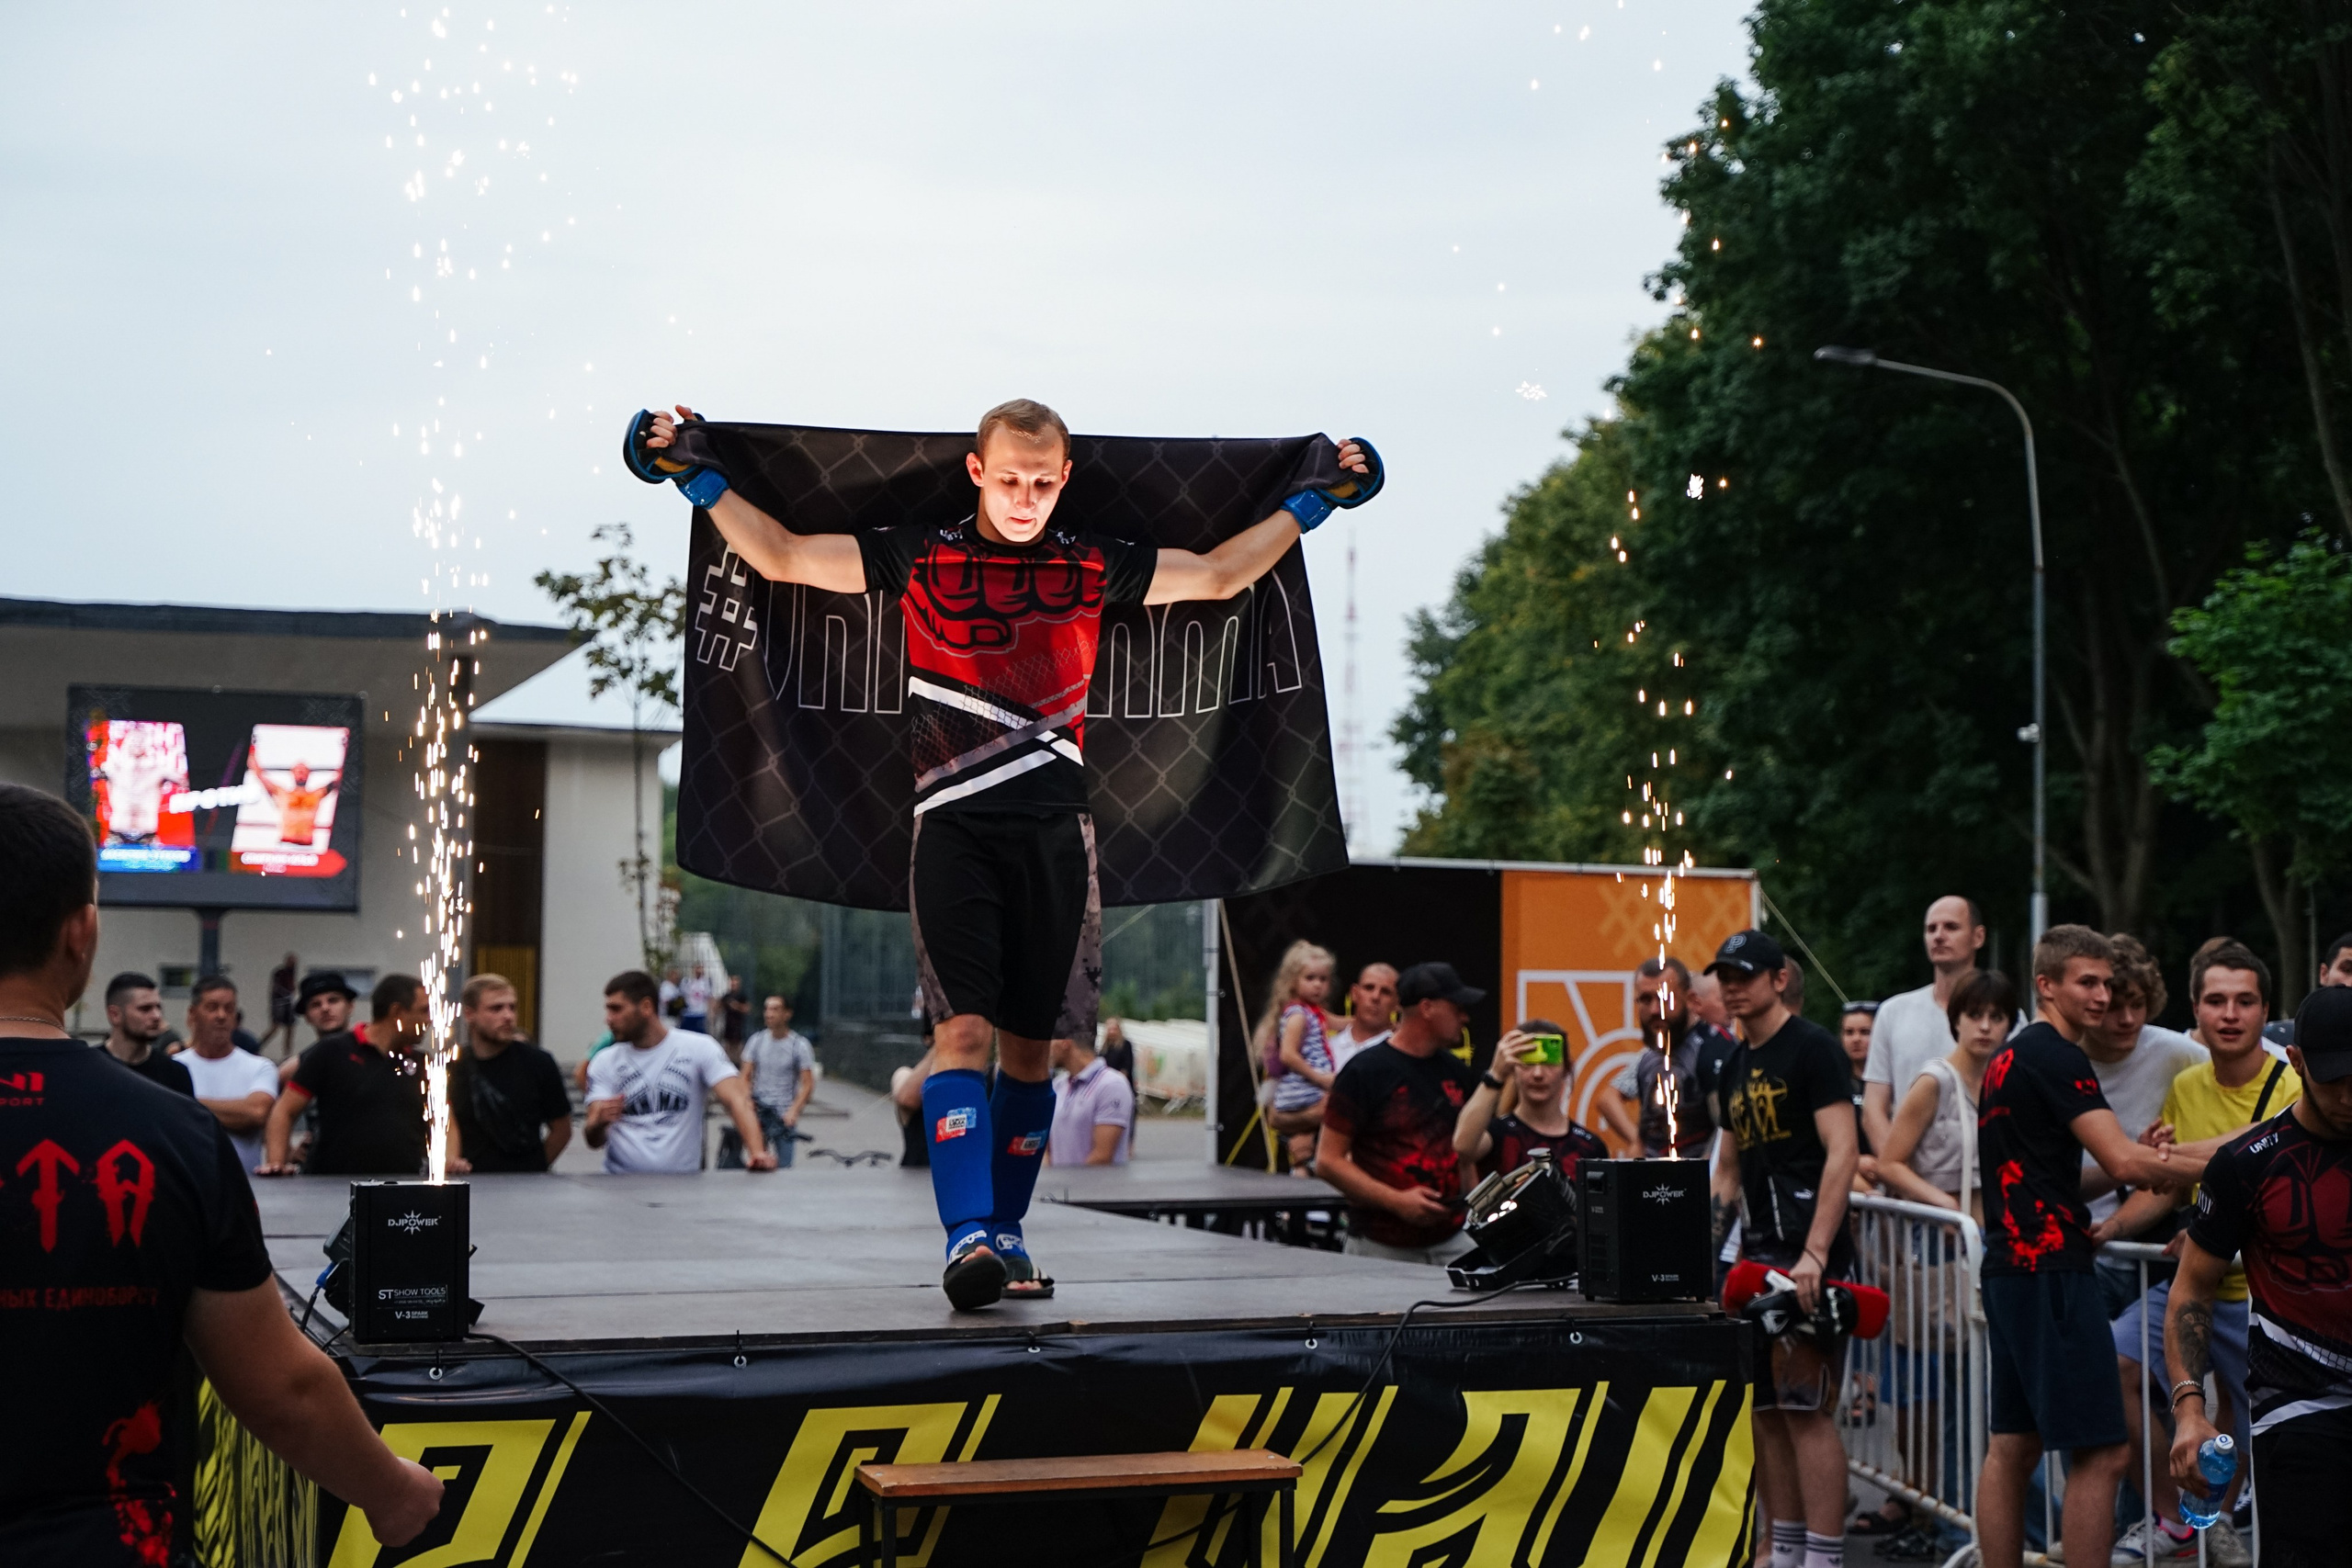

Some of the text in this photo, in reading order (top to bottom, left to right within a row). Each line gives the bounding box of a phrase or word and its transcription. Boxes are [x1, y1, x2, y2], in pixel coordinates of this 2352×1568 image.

[388, 1217, 439, 1227] DJPOWER
[393, 1288, 419, 1297] SHOW
[419, 1287, 447, 1296] TOOLS
[395, 1311, 411, 1319] V-3
